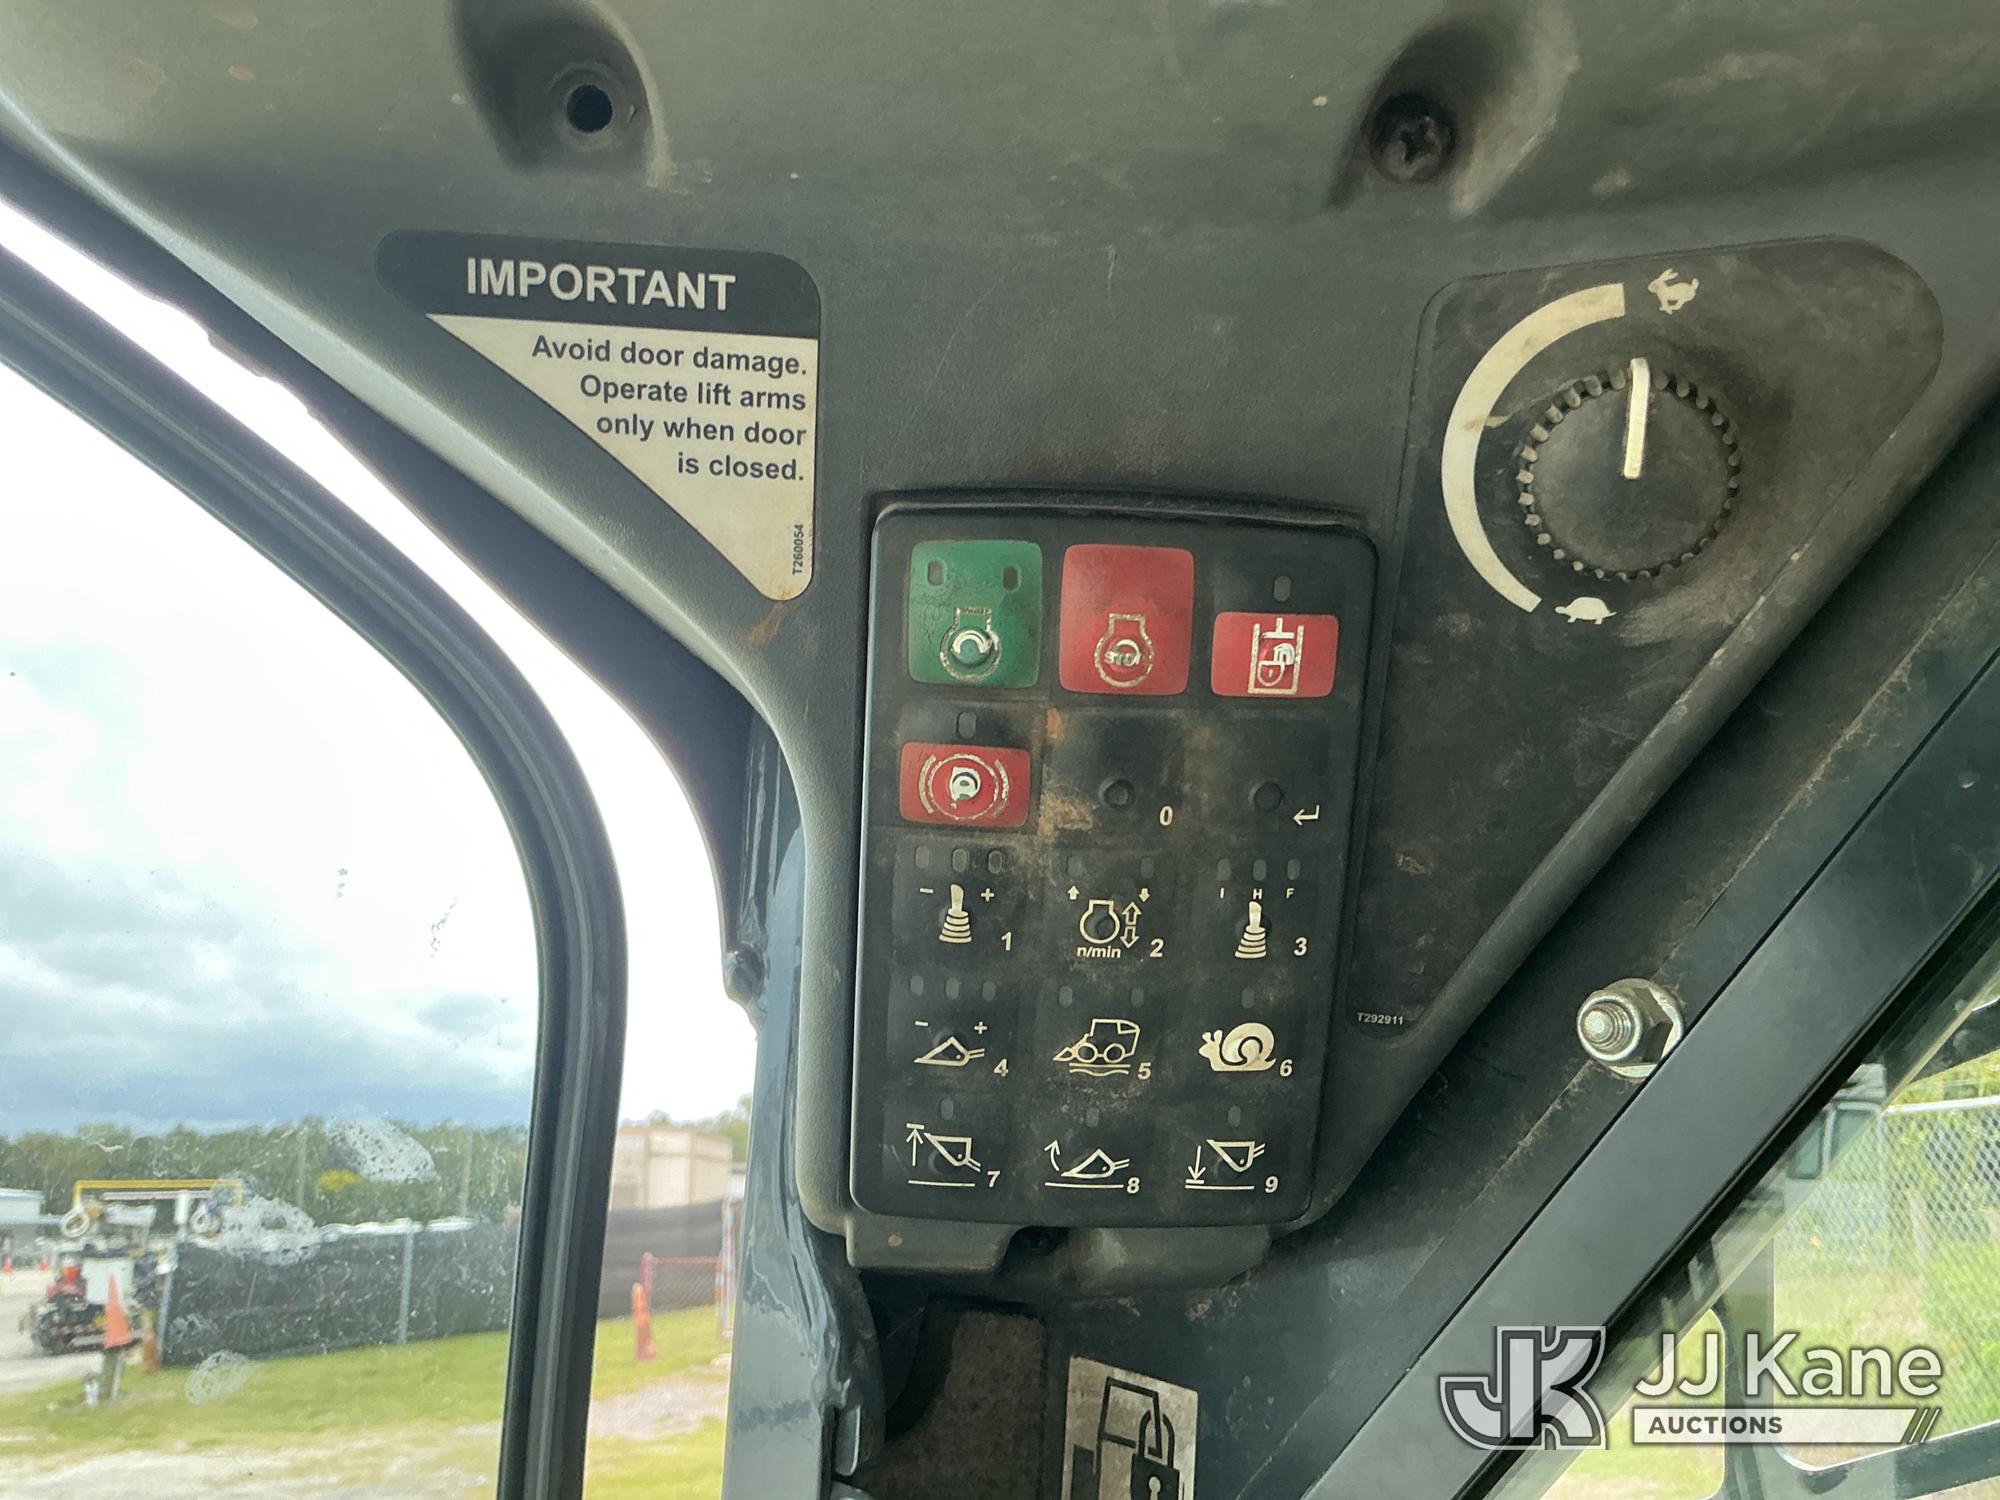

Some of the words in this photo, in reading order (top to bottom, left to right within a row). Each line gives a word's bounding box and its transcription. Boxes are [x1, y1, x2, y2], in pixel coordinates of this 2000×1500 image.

[466, 257, 736, 311] IMPORTANT
[531, 334, 611, 362] Avoid
[620, 341, 685, 367] door
[692, 346, 807, 378] damage.
[580, 374, 688, 403] Operate
[697, 381, 732, 406] lift
[739, 389, 807, 411] arms
[596, 414, 654, 441] only
[663, 416, 735, 442] when
[744, 420, 807, 446] door
[677, 452, 700, 474] is
[708, 454, 805, 481] closed.
[792, 523, 804, 576] T260054
[1159, 805, 1174, 826] 0
[1252, 888, 1263, 900] H
[1286, 887, 1295, 899] F
[1001, 931, 1012, 951] 1
[1149, 938, 1164, 958] 2
[1293, 936, 1307, 956] 3
[1077, 945, 1122, 959] n/min
[1357, 1012, 1404, 1026] T292911
[993, 1058, 1009, 1077] 4
[1137, 1062, 1152, 1080] 5
[1279, 1058, 1293, 1077] 6
[987, 1170, 1001, 1188] 7
[1126, 1176, 1140, 1194] 8
[1264, 1175, 1279, 1194] 9
